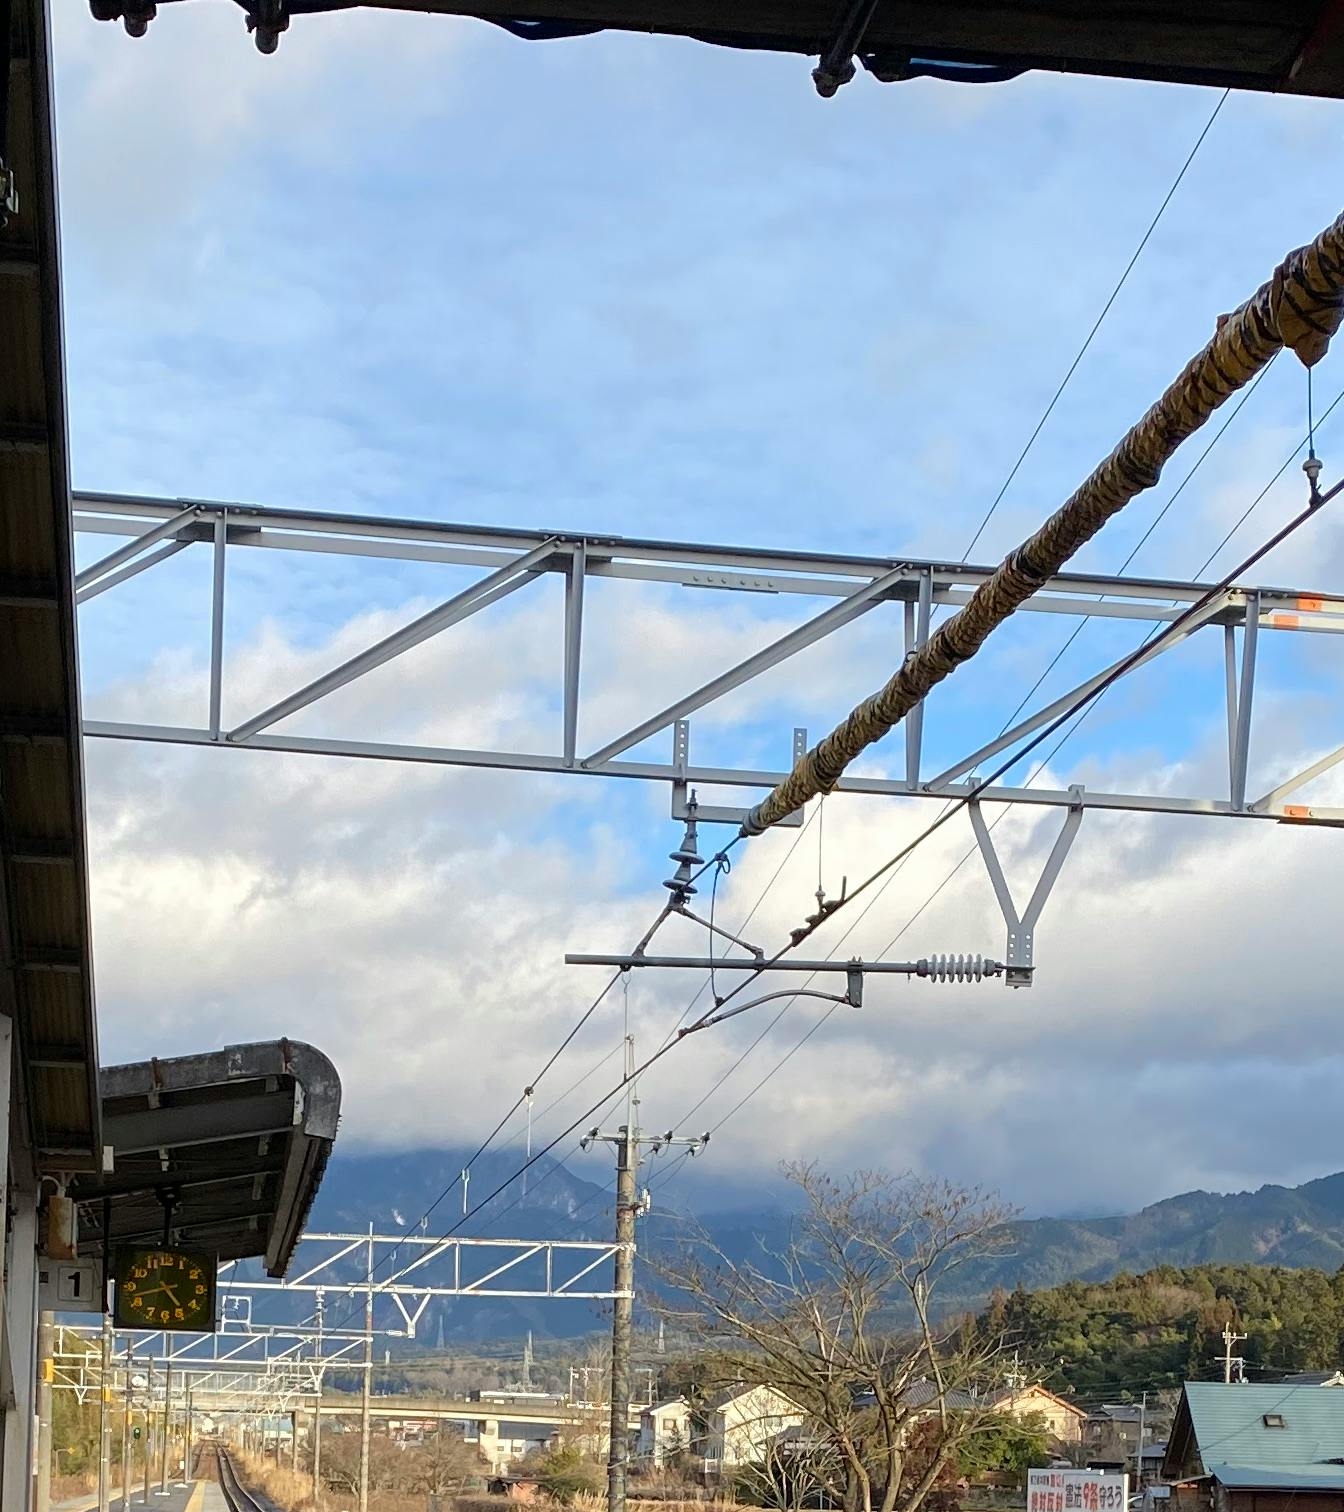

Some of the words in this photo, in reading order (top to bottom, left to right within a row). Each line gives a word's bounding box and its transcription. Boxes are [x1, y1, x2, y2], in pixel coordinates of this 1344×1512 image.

[147, 1255, 158, 1269] 11
[160, 1254, 173, 1266] 12
[135, 1268, 147, 1278] 10
[189, 1269, 198, 1280] 2
[68, 1272, 80, 1296] 1
[127, 1282, 136, 1291] 9
[195, 1284, 204, 1294] 3
[188, 1299, 196, 1309] 4
[147, 1306, 155, 1317] 7
[161, 1311, 170, 1321] 6
[175, 1308, 184, 1318] 5
[1065, 1482, 1122, 1512] 憲法9条守ろう
